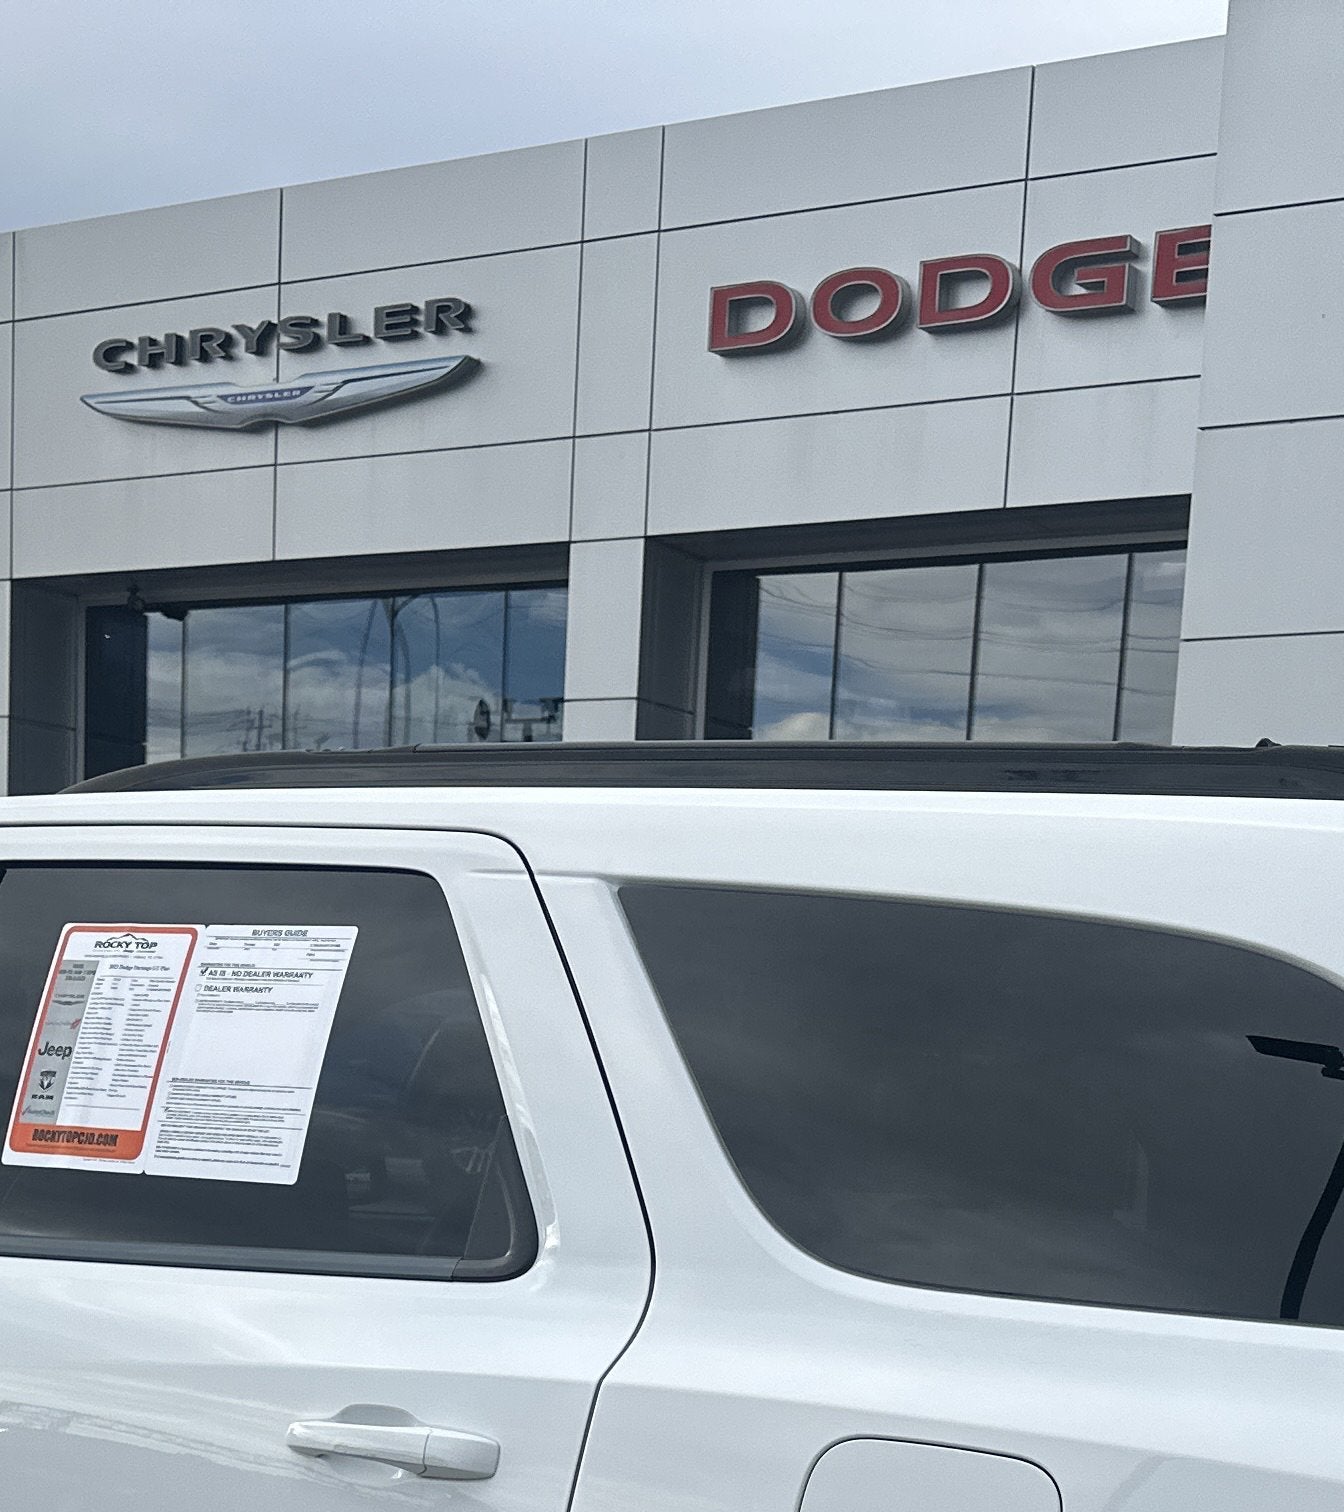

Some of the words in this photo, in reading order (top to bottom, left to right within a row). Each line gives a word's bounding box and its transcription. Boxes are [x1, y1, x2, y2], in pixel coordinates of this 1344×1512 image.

[708, 225, 1212, 354] DODGE
[93, 297, 470, 373] CHRYSLER
[94, 940, 132, 949] ROCKY
[135, 941, 158, 950] TOP
[208, 969, 218, 977] AS
[231, 970, 242, 978] NO
[243, 971, 272, 979] DEALER
[272, 971, 314, 980] WARRANTY
[203, 985, 232, 993] DEALER
[232, 986, 274, 994] WARRANTY
[38, 1042, 73, 1060] Jeep
